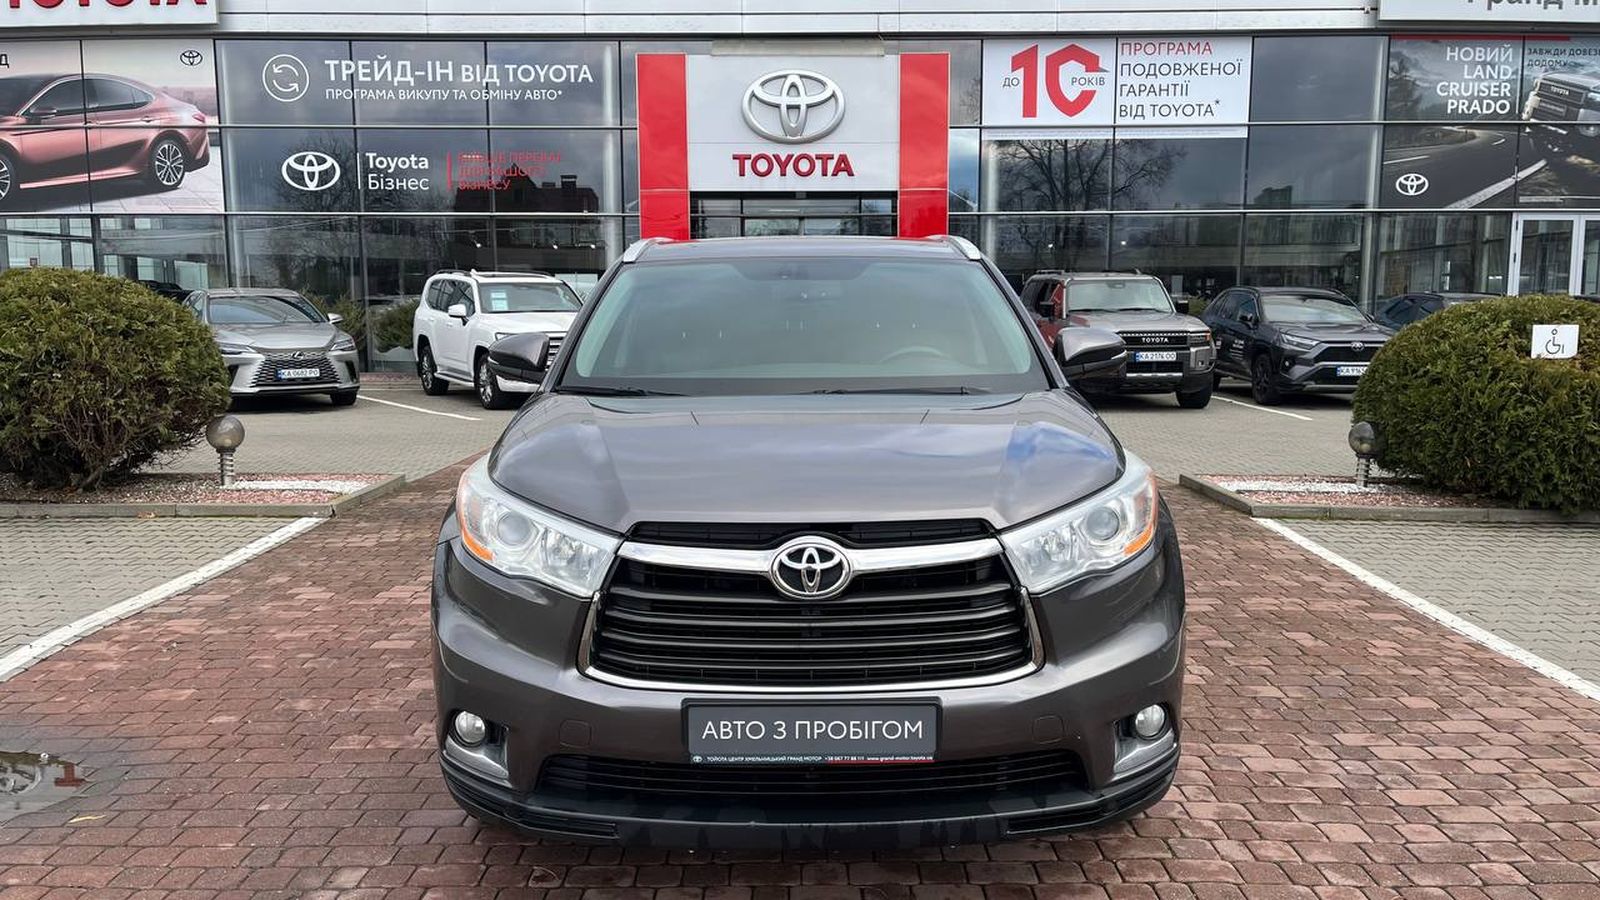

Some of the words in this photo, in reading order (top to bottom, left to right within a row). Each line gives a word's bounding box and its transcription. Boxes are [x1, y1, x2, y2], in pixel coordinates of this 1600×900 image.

[1121, 42, 1213, 56] ПРОГРАМА
[1446, 44, 1513, 62] НОВИЙ
[1569, 48, 1600, 57] ДОВЕЗ
[324, 54, 453, 87] ТРЕЙД-ІН
[461, 64, 500, 87] ВІД
[504, 64, 594, 83] TOYOTA
[1120, 58, 1243, 79] ПОДОВЖЕНОЇ
[1463, 64, 1513, 80] LAND
[1002, 77, 1020, 88] ДО
[1071, 76, 1106, 87] РОКІВ
[1119, 79, 1191, 97] ГАРАНТІЇ
[1436, 81, 1511, 98] CRUISER
[325, 88, 396, 101] ПРОГРАМА
[398, 89, 450, 101] ВИКУПУ
[452, 89, 468, 100] ТА
[470, 89, 522, 101] ОБМІНУ
[1119, 104, 1146, 120] ВІД
[1447, 99, 1511, 115] PRADO
[365, 152, 429, 173] Toyota
[732, 153, 855, 177] TOYOTA
[367, 173, 430, 191] Бізнес
[701, 720, 766, 740] АВТО
[773, 720, 787, 740] З
[795, 720, 923, 740] ПРОБІГОМ
